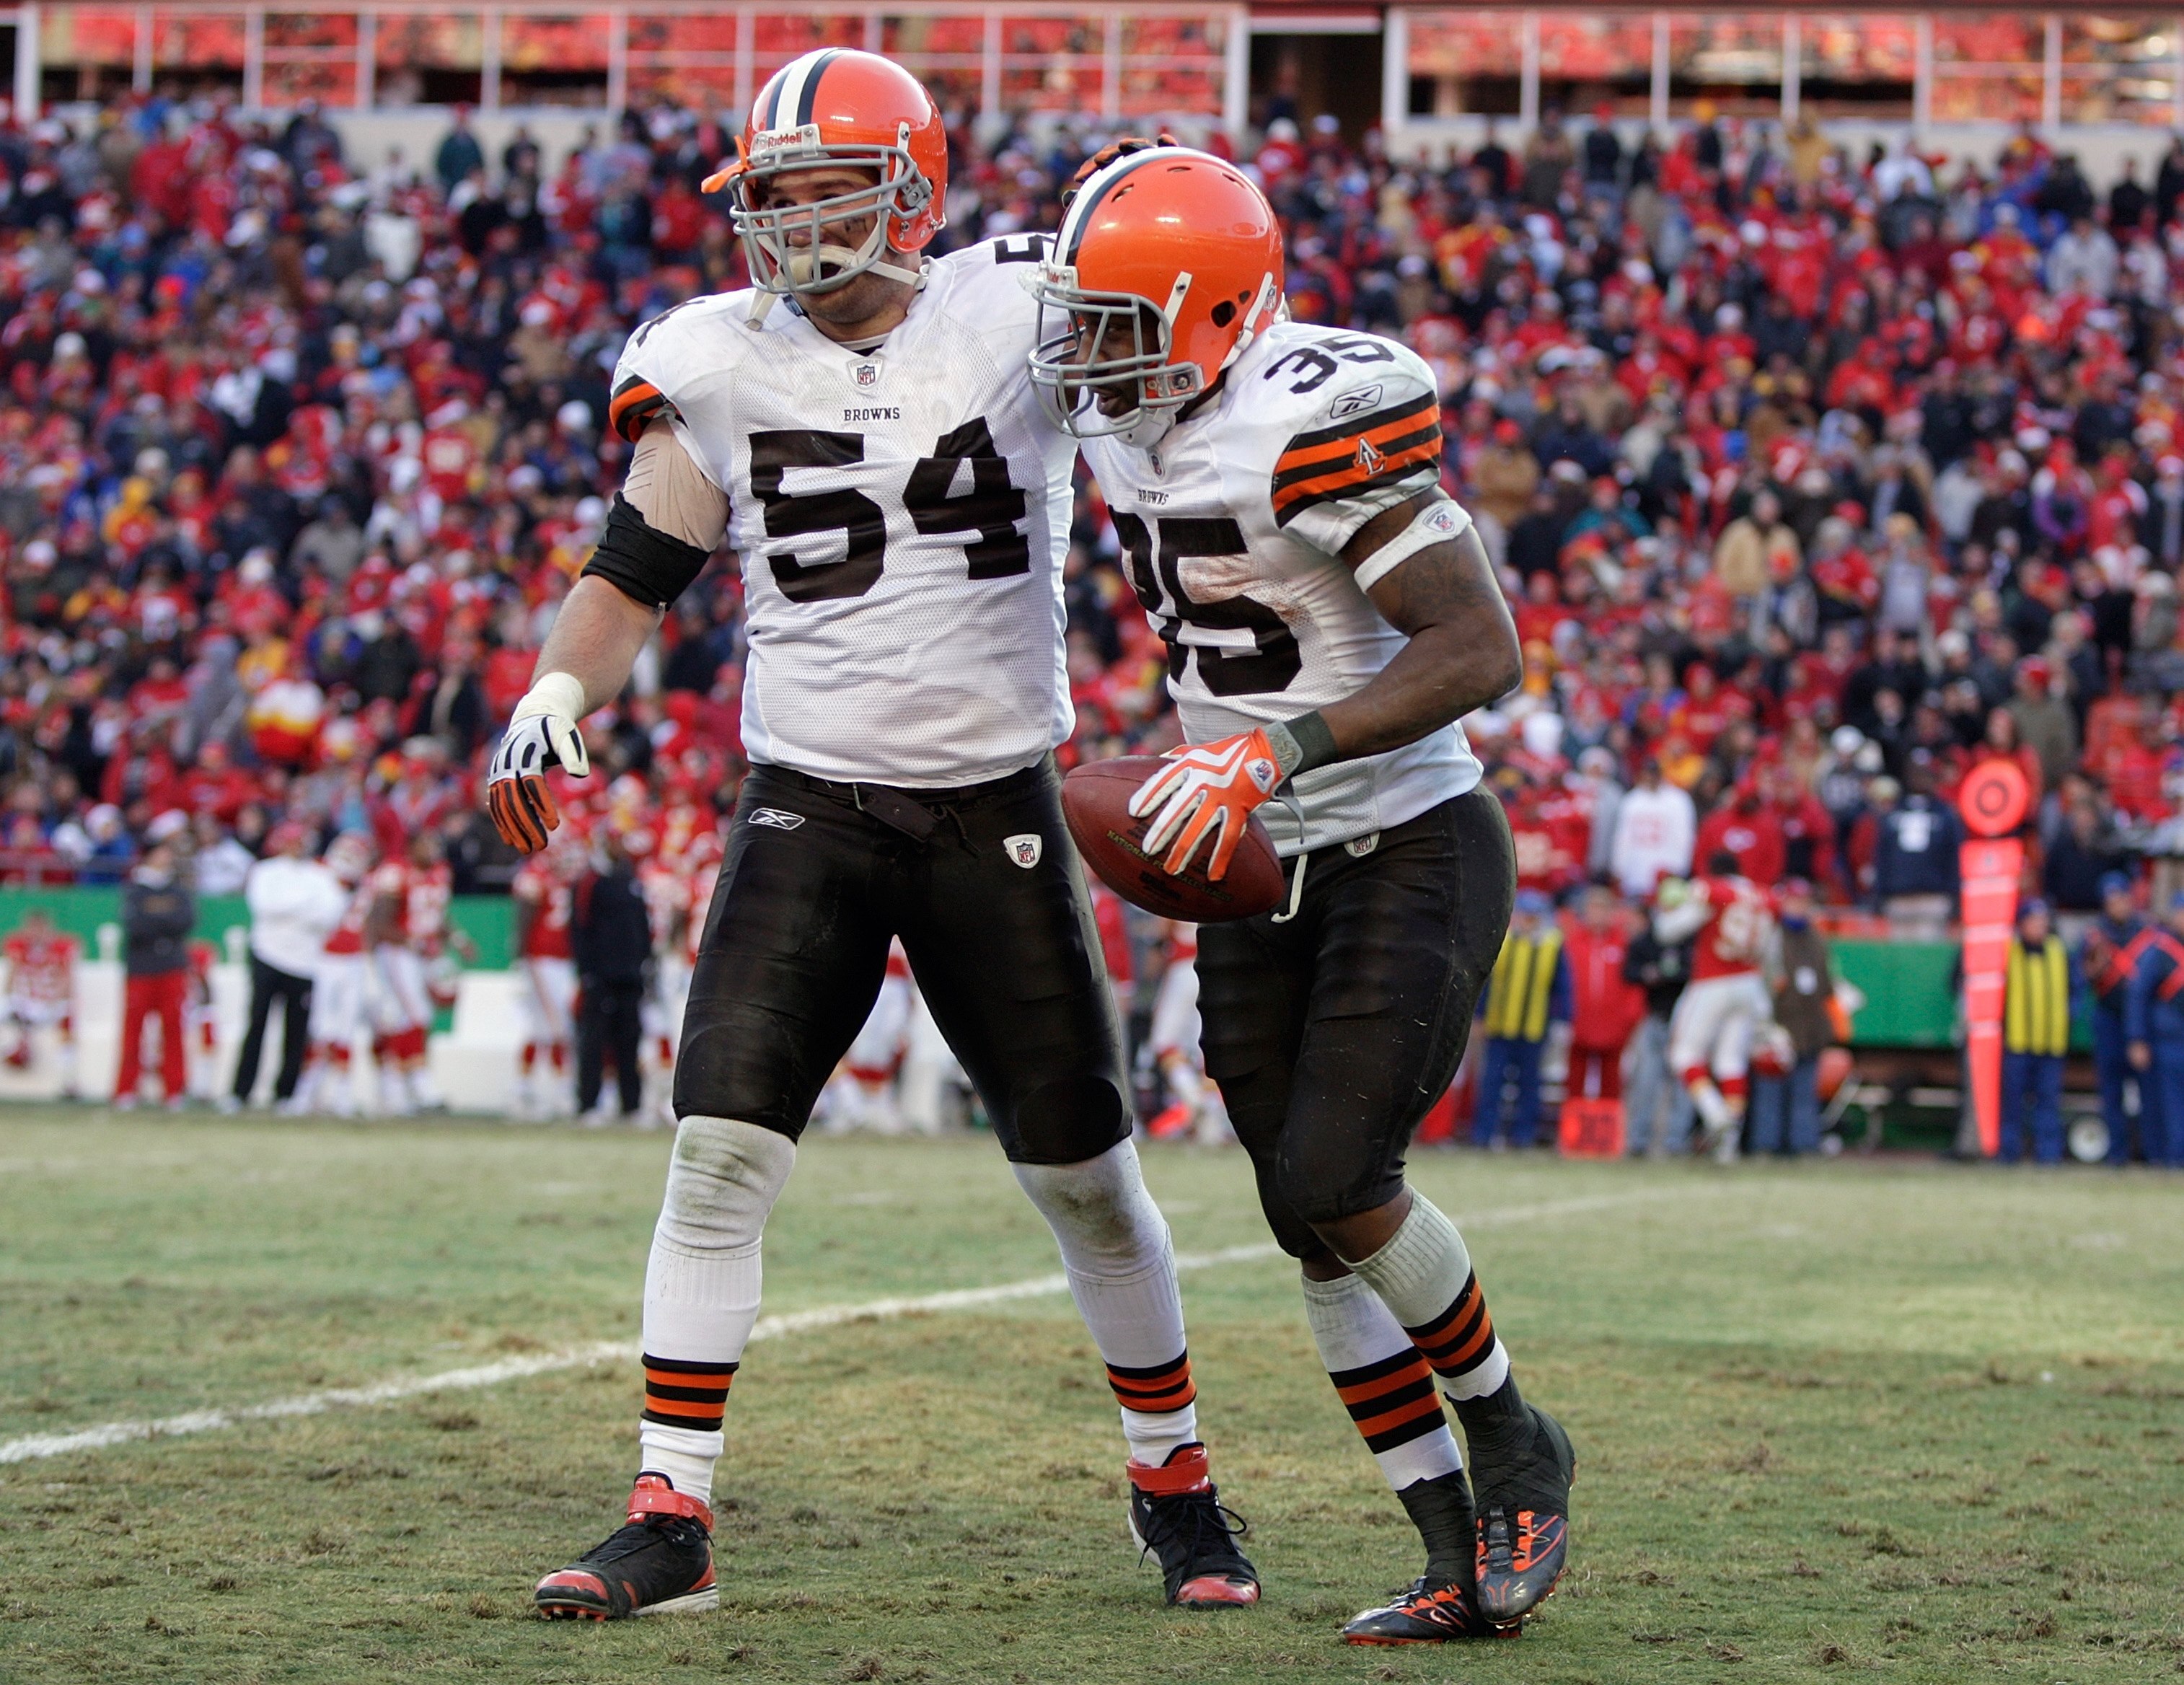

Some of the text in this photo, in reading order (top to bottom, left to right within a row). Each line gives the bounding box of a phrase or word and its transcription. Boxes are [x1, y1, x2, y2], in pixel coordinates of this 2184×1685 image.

[767, 132, 802, 147] Riddell
[1264, 333, 1396, 394] 35
[844, 407, 900, 421] BROWNS
[748, 415, 1030, 603] 54
[1137, 489, 1169, 505] BROWNS
[1106, 830, 1150, 862] NATIONAL
